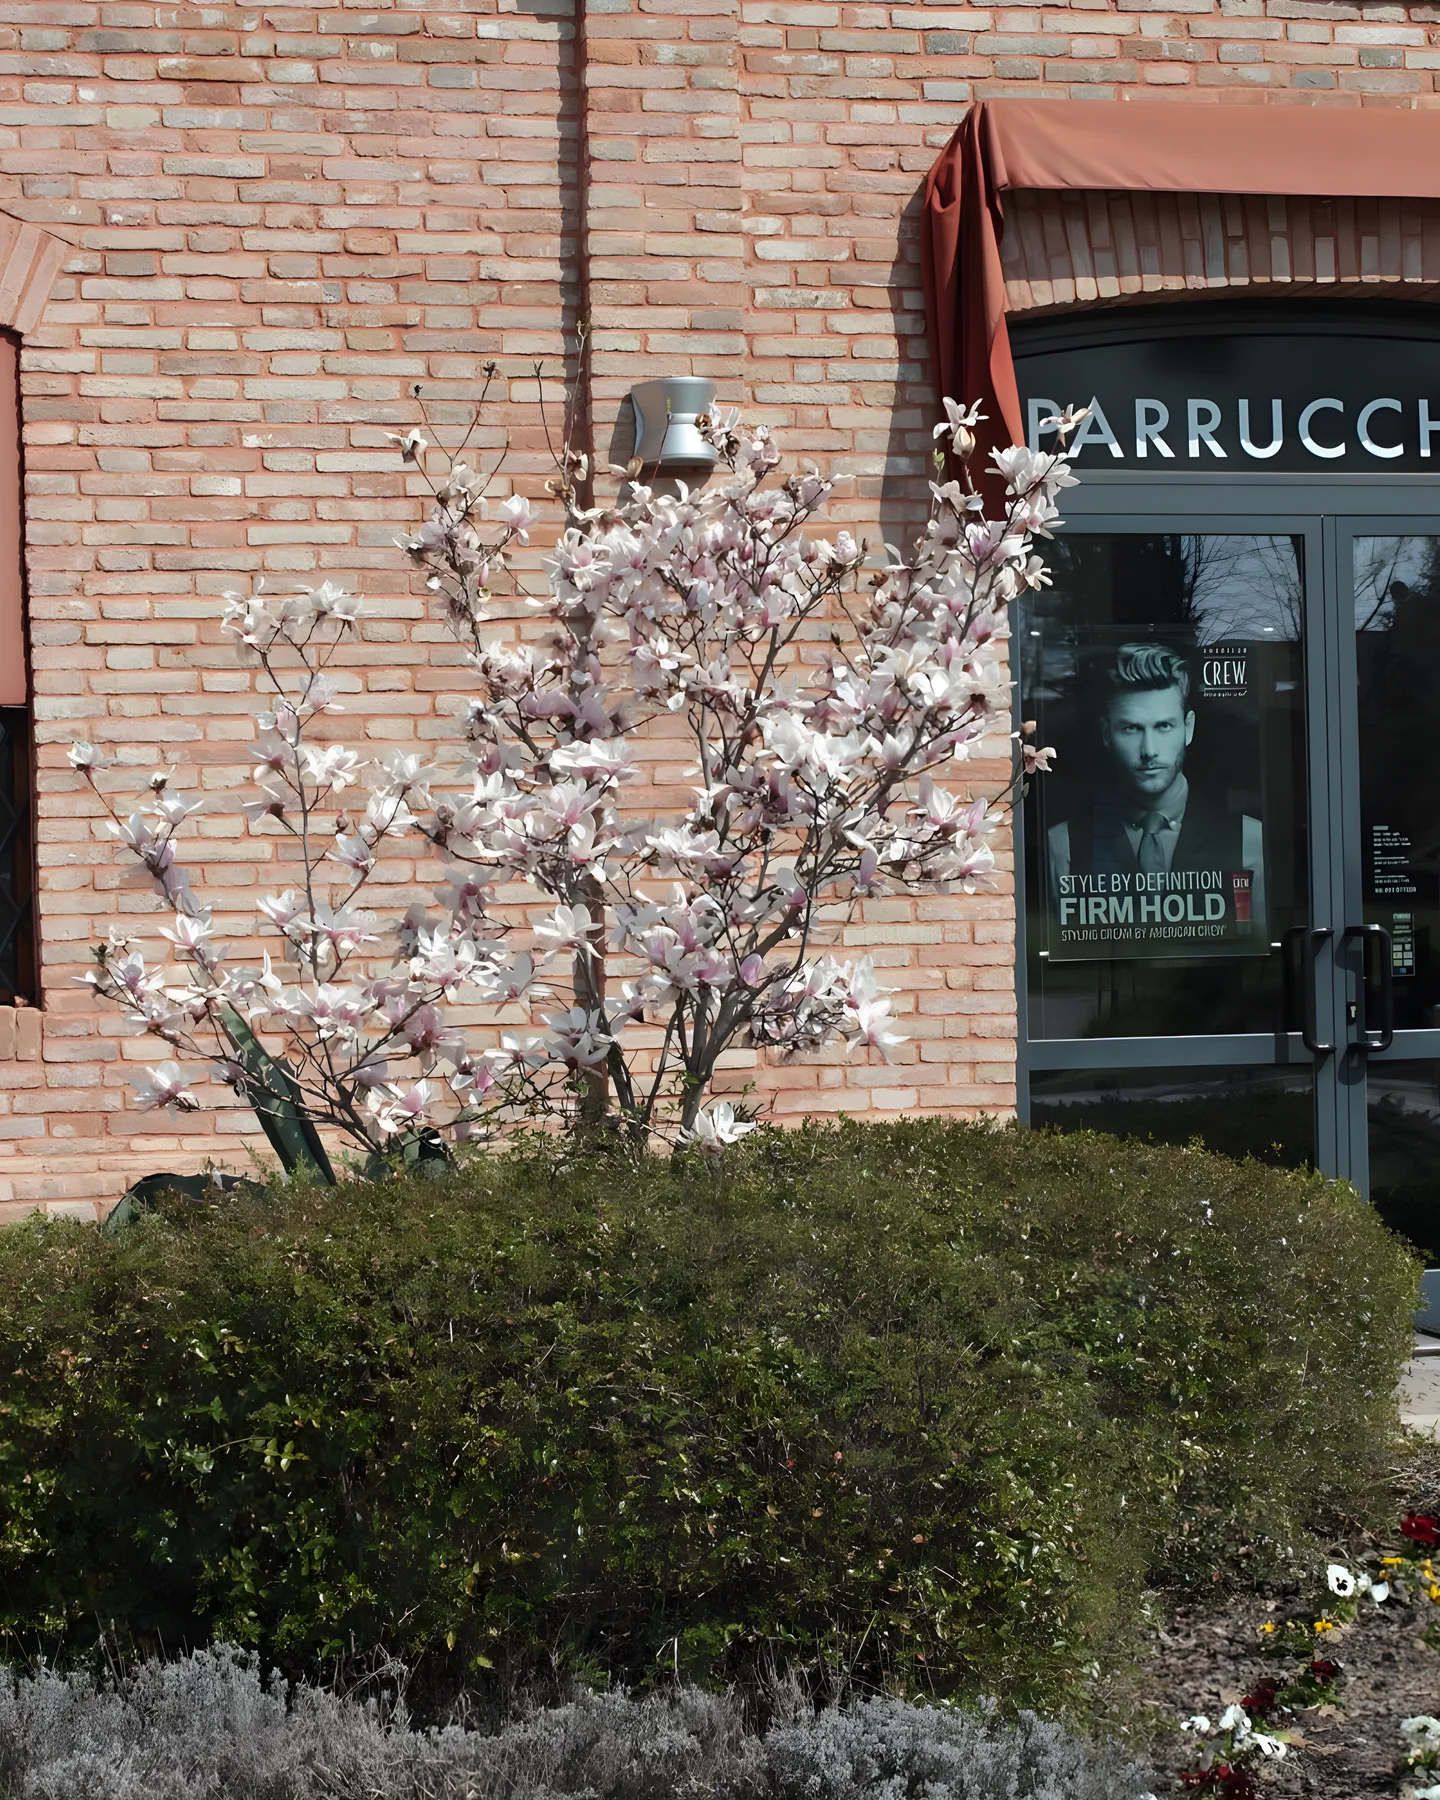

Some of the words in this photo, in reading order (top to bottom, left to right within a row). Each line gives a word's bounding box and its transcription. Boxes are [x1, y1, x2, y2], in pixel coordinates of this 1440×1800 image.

[1060, 874, 1107, 894] STYLE
[1111, 873, 1131, 892] BY
[1135, 870, 1222, 892] DEFINITION
[1060, 896, 1134, 925] FIRM
[1140, 893, 1226, 923] HOLD
